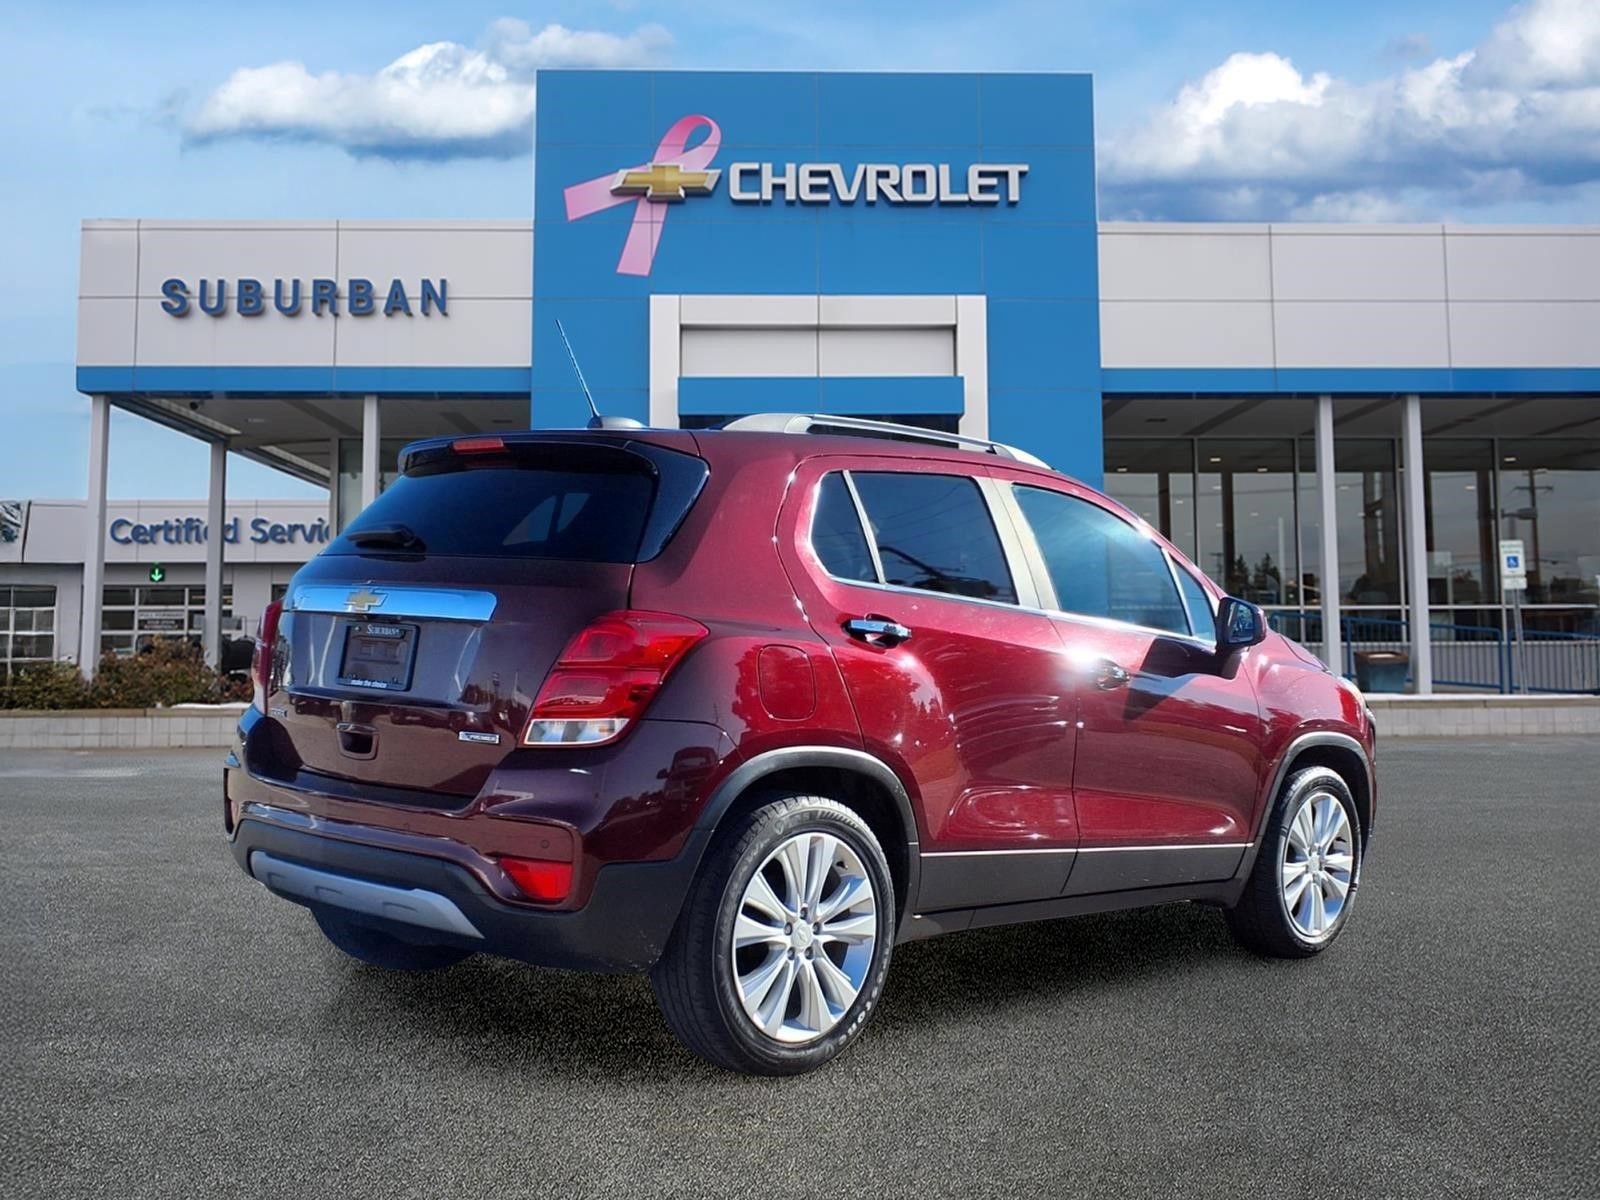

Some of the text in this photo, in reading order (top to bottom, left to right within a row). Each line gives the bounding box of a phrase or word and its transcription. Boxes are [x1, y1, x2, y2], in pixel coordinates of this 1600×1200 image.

[729, 162, 1029, 206] CHEVROLET
[161, 278, 449, 317] SUBURBAN
[109, 517, 240, 544] Certifid
